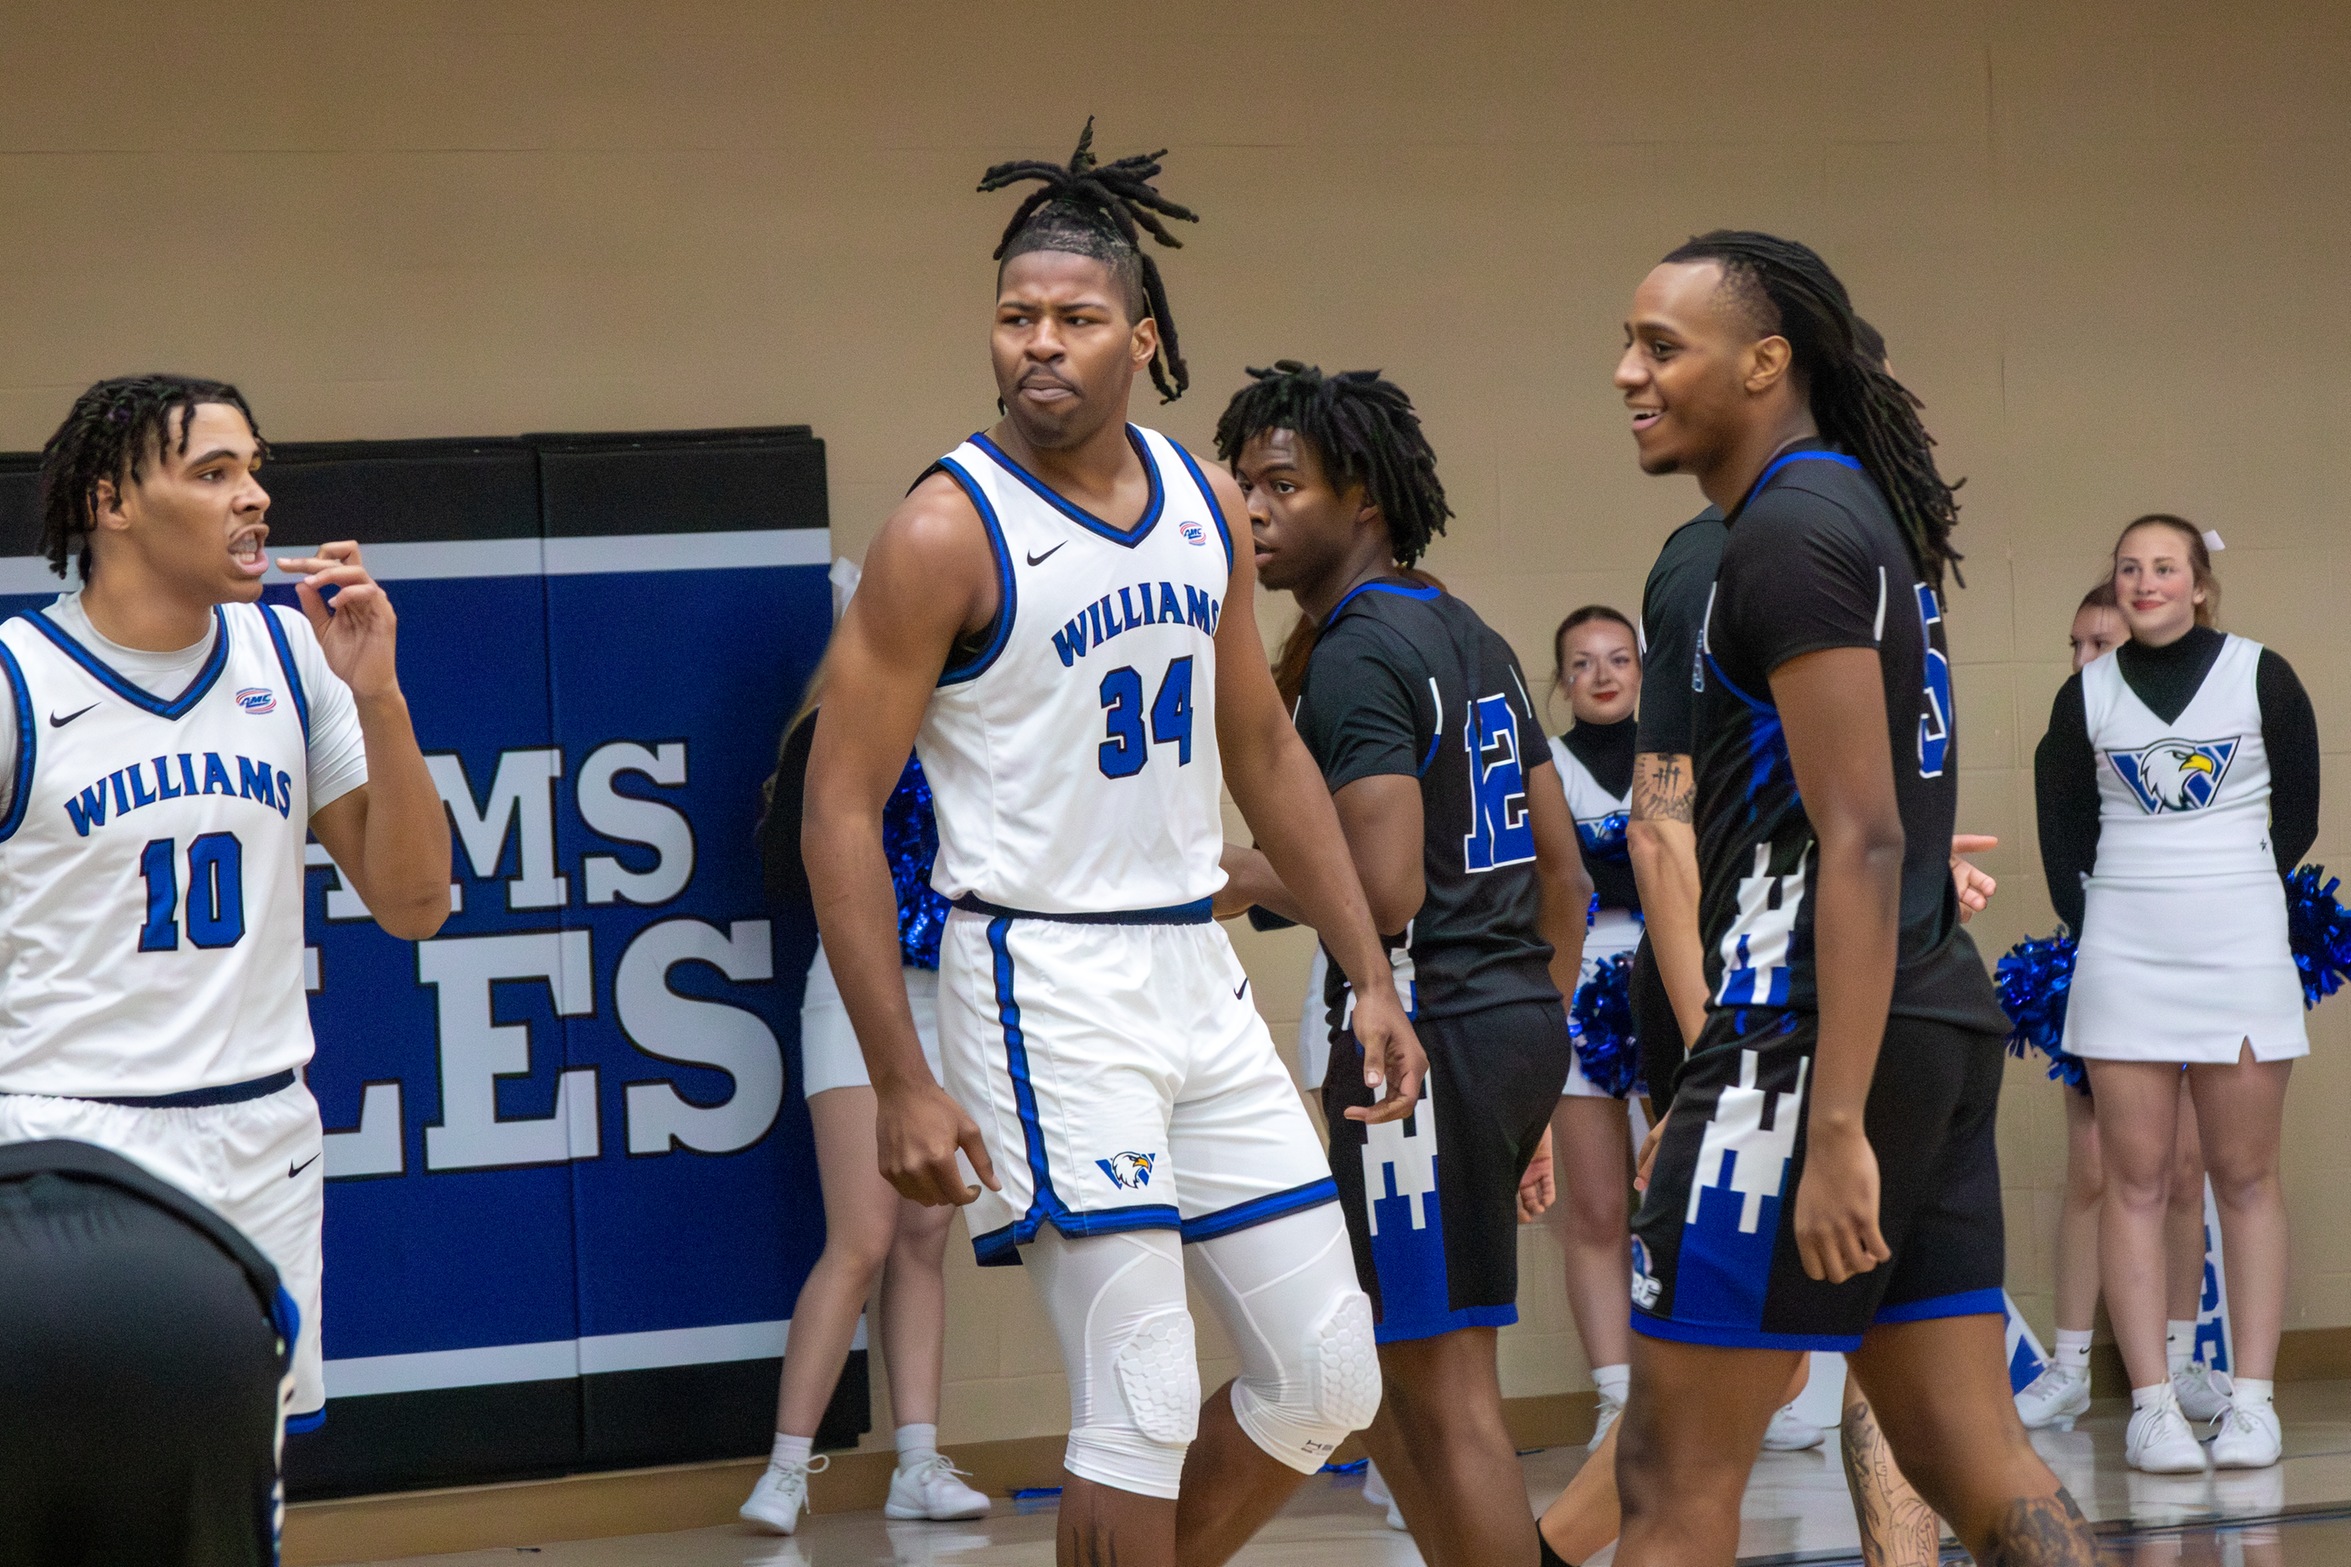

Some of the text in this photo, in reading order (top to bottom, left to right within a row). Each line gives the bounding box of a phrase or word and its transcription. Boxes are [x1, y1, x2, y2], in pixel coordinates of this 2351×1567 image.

[1051, 582, 1220, 667] WILLIAMS
[1099, 654, 1193, 780] 34
[64, 752, 292, 837] WILLIAMS
[1464, 692, 1537, 874] 12
[138, 831, 246, 953] 10
